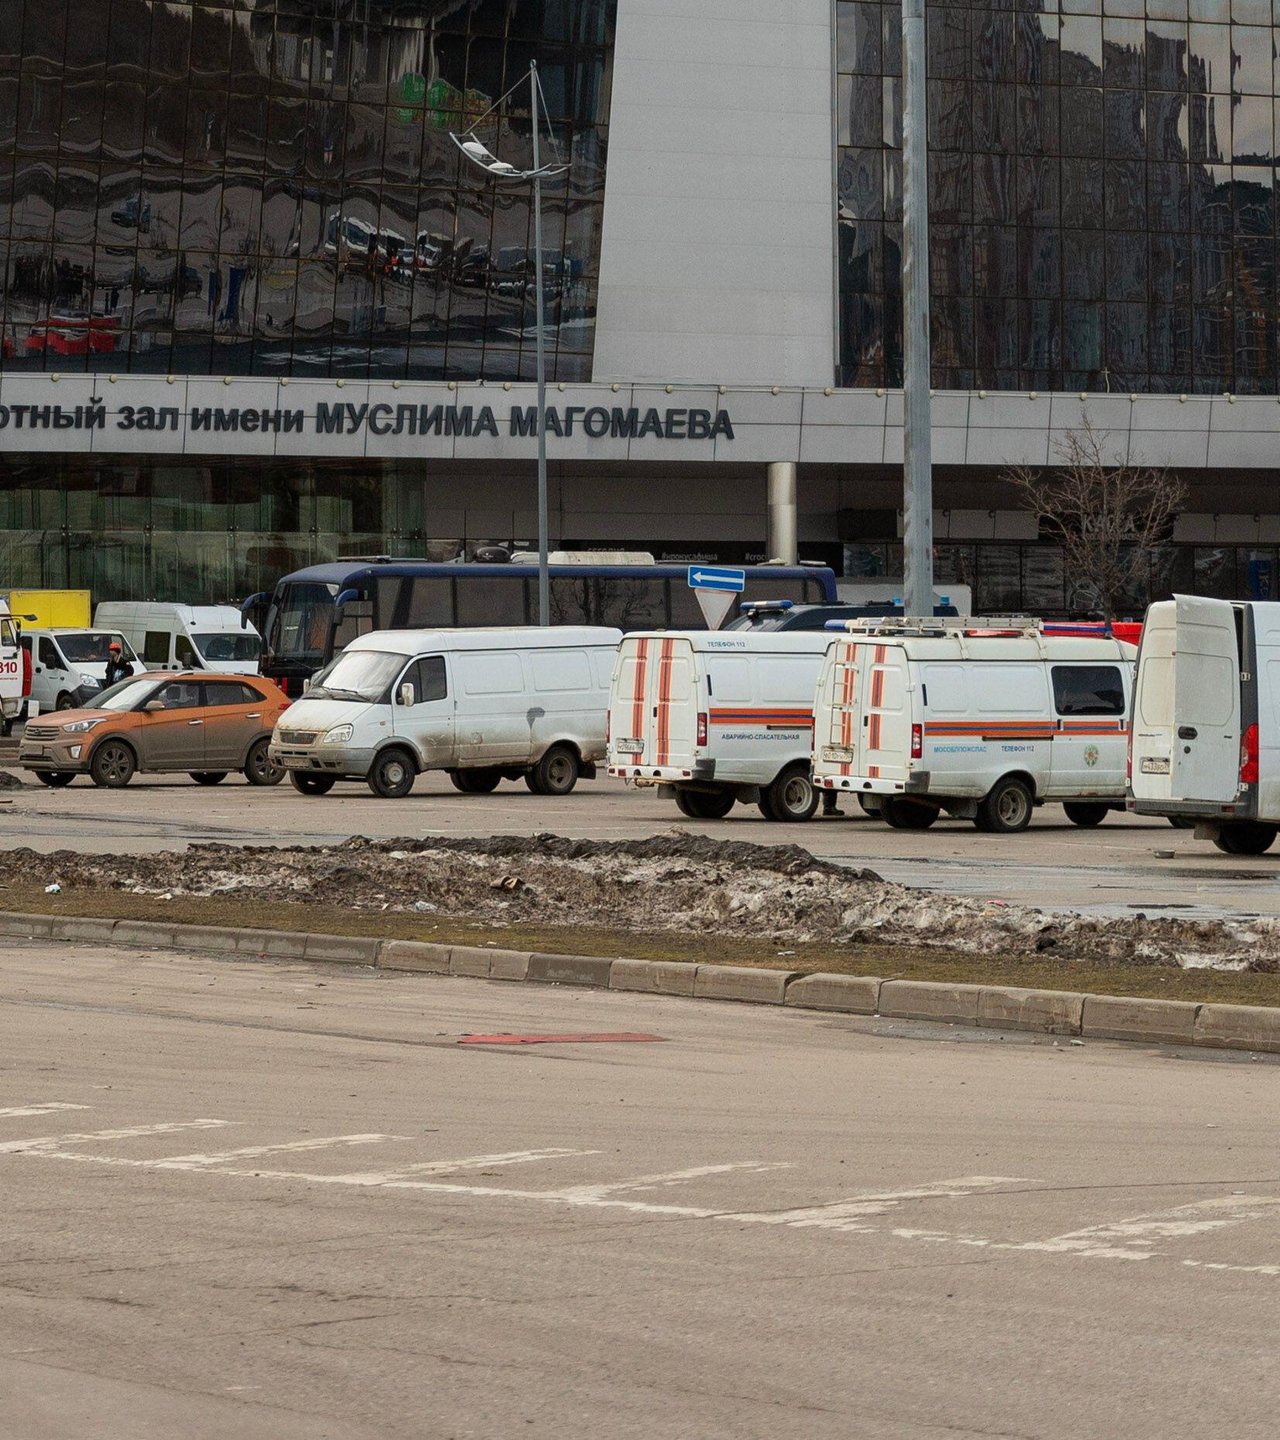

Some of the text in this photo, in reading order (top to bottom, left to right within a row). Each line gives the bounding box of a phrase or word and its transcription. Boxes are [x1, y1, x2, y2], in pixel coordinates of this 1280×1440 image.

[116, 406, 180, 432] зал
[191, 407, 304, 433] имени
[316, 402, 499, 437] МУСЛИМА
[509, 406, 735, 440] МАГОМАЕВА
